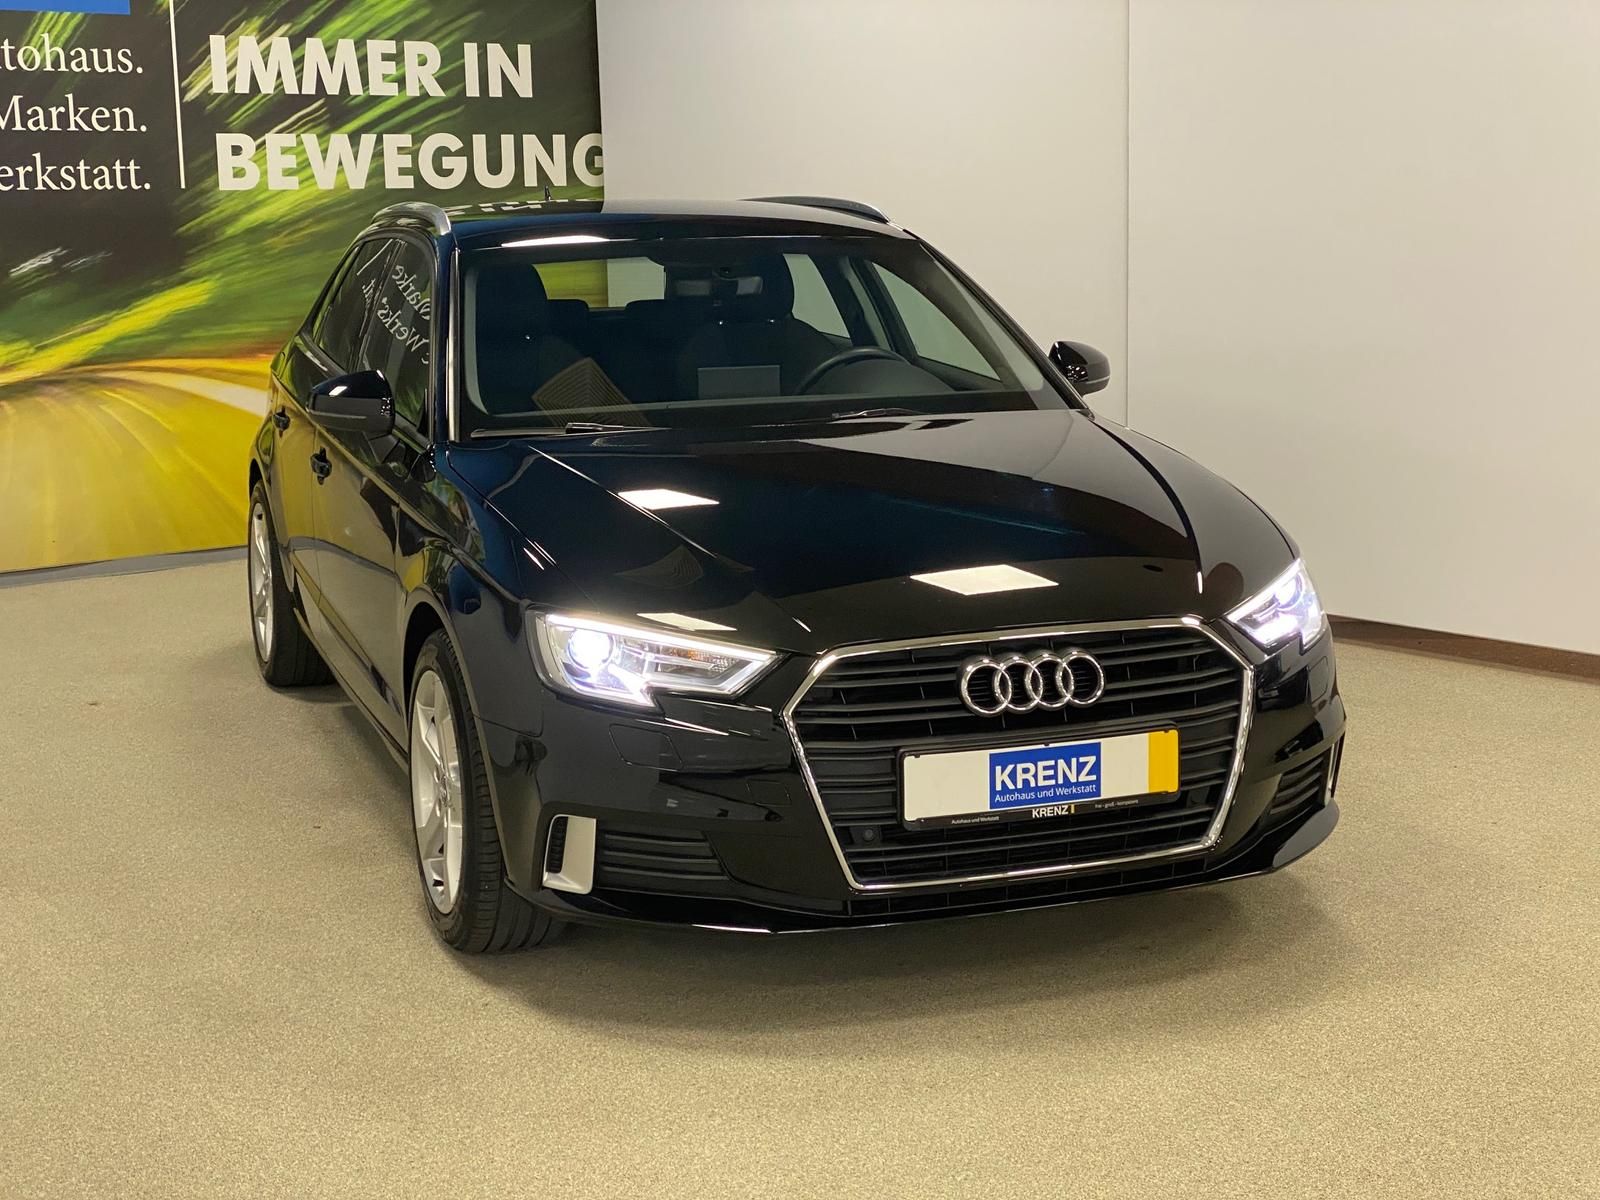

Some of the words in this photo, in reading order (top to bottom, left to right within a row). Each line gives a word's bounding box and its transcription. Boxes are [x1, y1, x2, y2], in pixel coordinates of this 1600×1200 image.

[0, 32, 144, 74] tohaus.
[209, 34, 446, 97] IMMER
[463, 42, 533, 98] IN
[0, 152, 151, 191] erkstatt.
[215, 132, 604, 191] BEWEGUNG
[995, 755, 1097, 791] KRENZ
[994, 791, 1036, 803] Autohaus
[1037, 788, 1054, 798] und
[1055, 784, 1097, 796] Werkstatt
[1032, 805, 1069, 819] KRENZ
